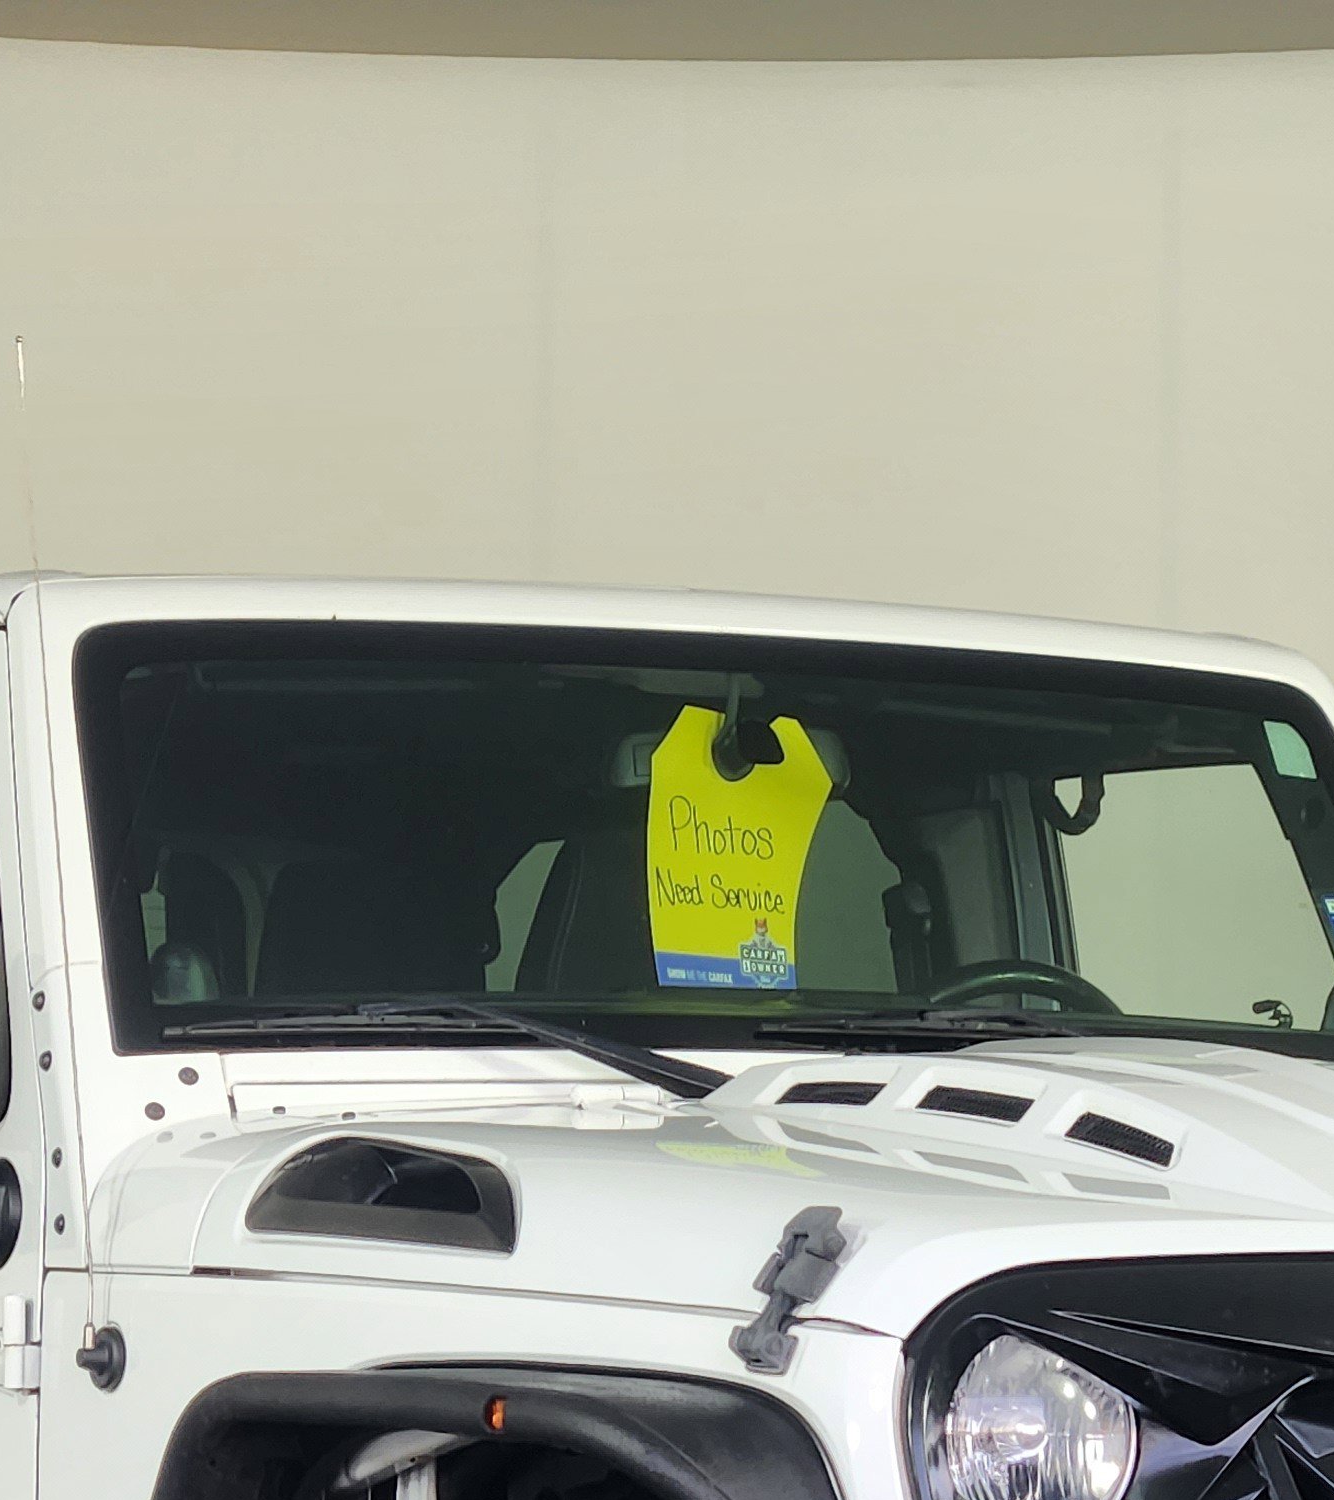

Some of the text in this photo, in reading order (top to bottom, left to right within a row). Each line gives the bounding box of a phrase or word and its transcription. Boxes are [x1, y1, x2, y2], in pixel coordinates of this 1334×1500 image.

[669, 795, 774, 860] Photos
[656, 866, 785, 914] Need Service
